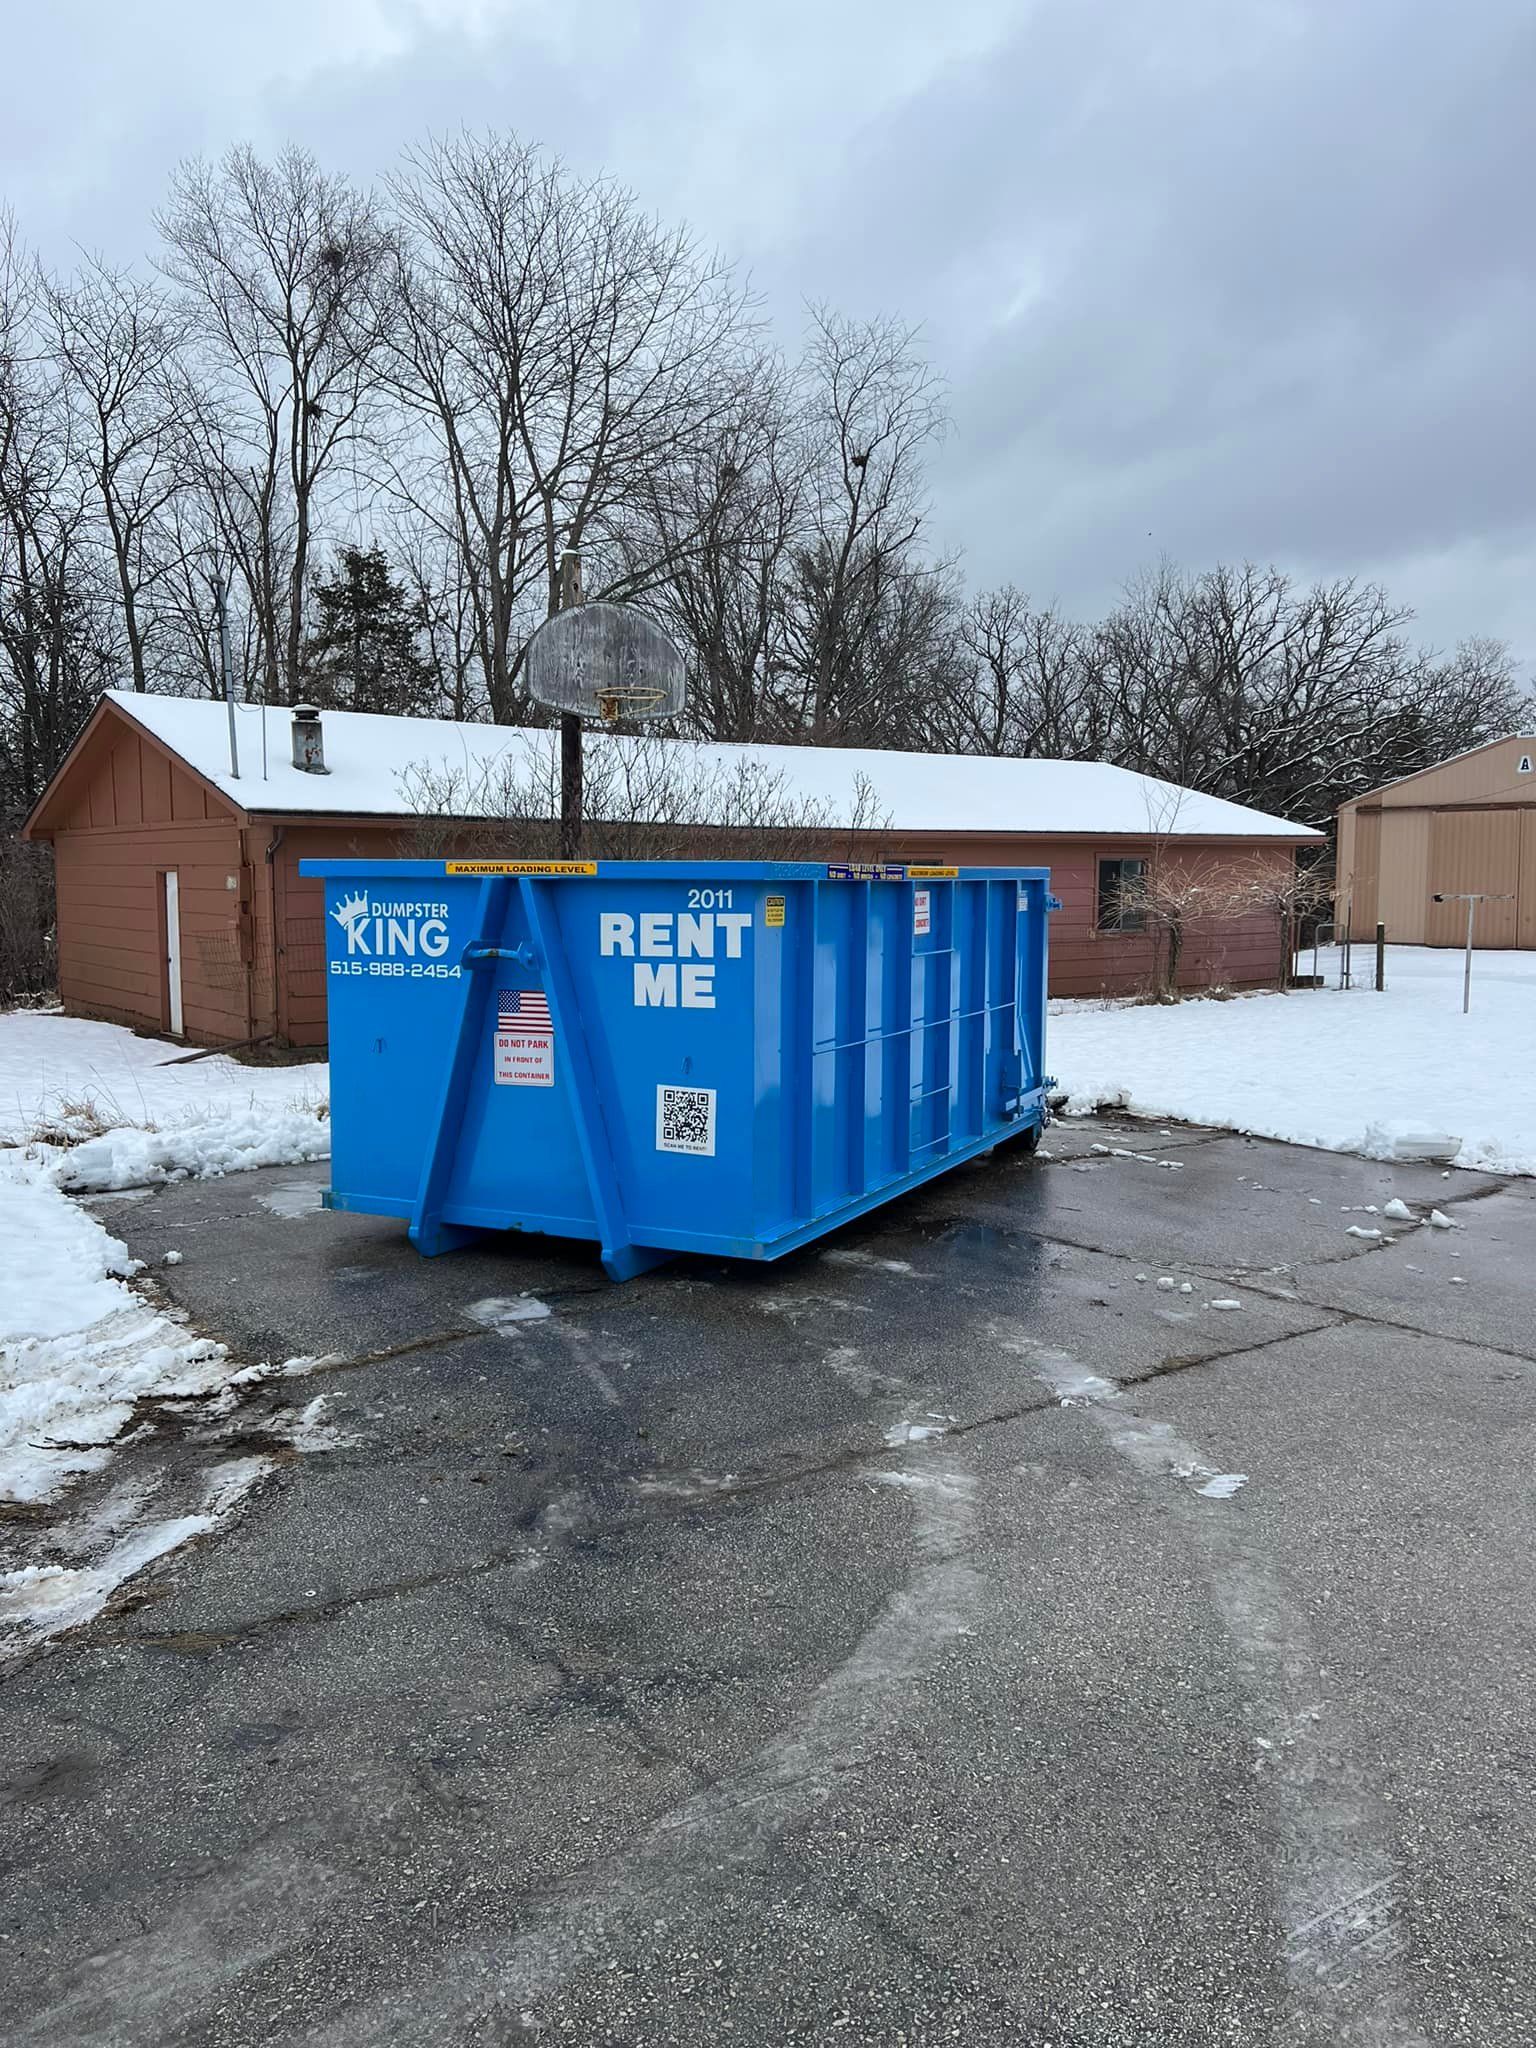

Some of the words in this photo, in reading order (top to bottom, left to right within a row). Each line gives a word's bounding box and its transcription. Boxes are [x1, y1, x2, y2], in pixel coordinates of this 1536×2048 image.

[1521, 757, 1530, 770] A
[455, 865, 504, 873] MAXIMUM
[507, 865, 552, 873] LOADING
[688, 889, 733, 909] 2011
[371, 902, 449, 918] DUMPSTER
[347, 918, 450, 957] KING
[600, 913, 752, 958] RENT
[330, 961, 461, 979] 515-988-2454
[634, 963, 716, 1008] ME
[498, 1039, 509, 1048] DO
[511, 1039, 526, 1048] NOT
[528, 1040, 549, 1049] PARK
[514, 1071, 550, 1080] CONTAINER
